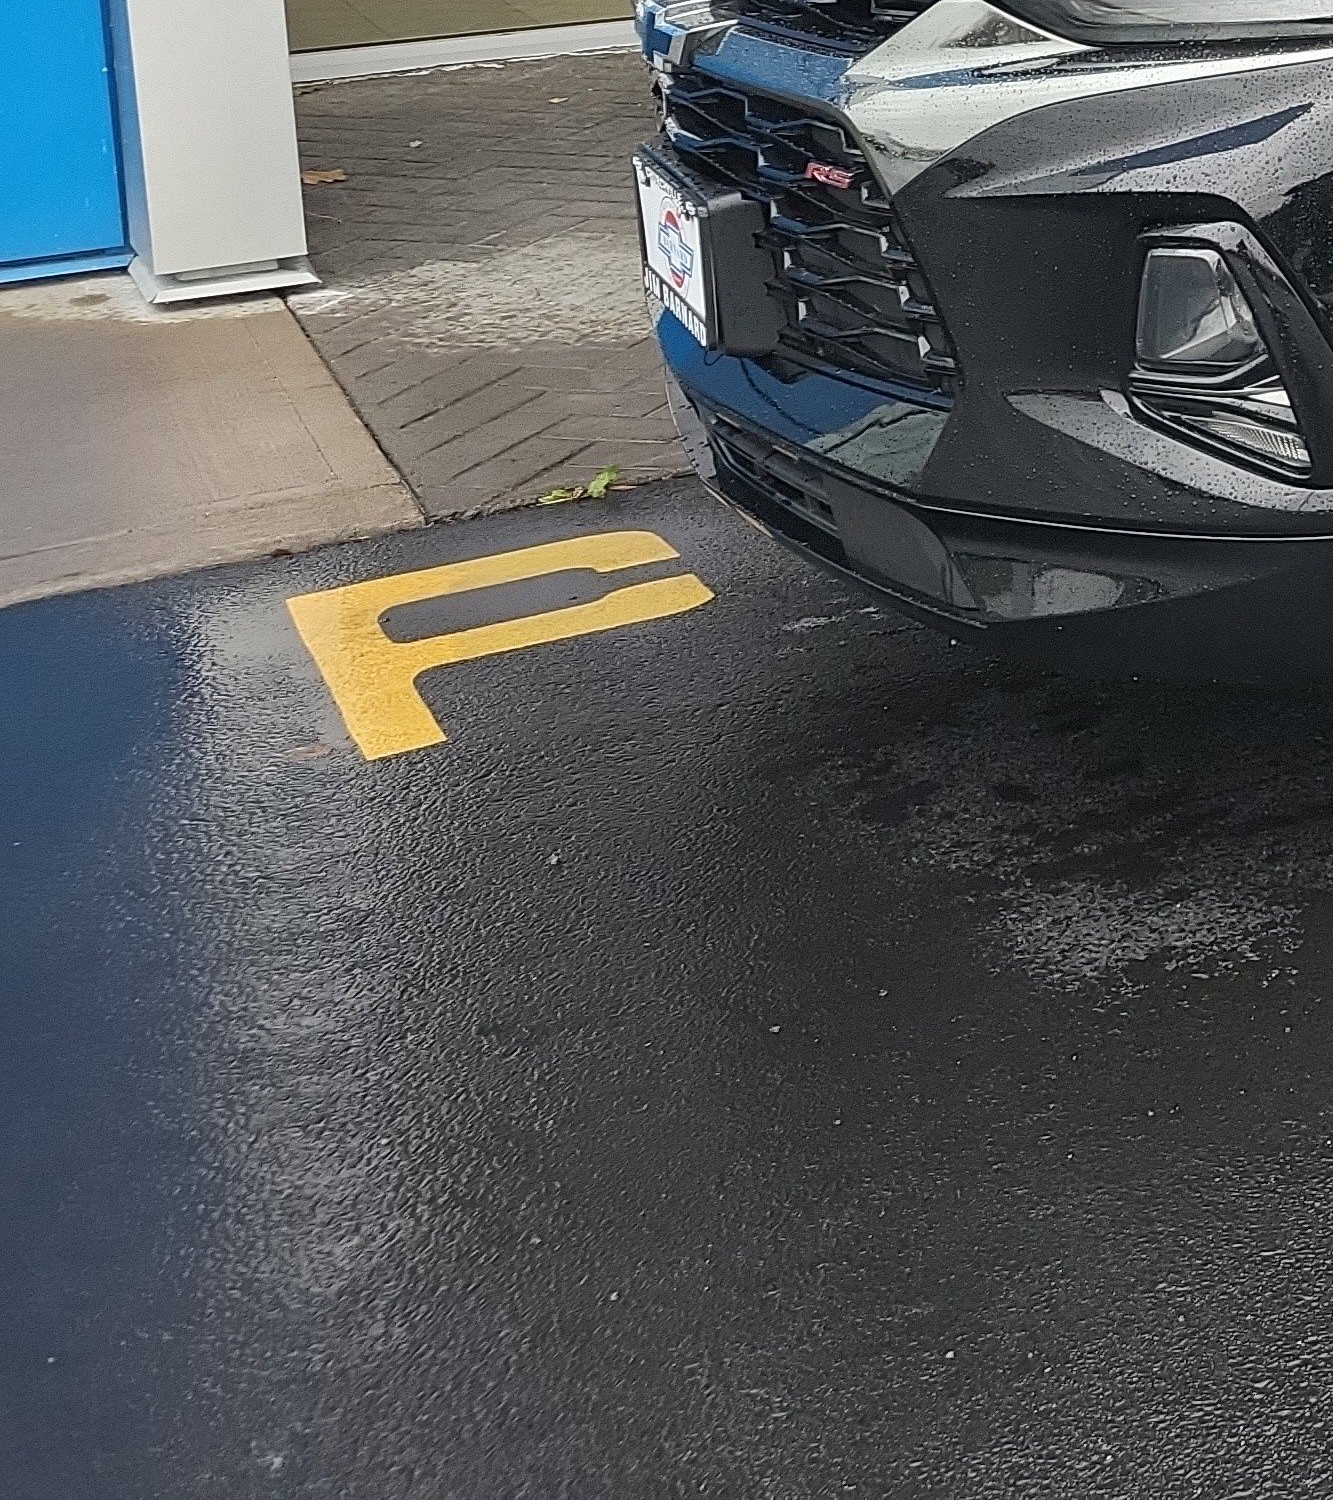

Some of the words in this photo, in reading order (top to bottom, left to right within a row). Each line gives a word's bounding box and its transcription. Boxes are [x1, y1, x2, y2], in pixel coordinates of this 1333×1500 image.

[804, 162, 854, 190] RS
[643, 266, 661, 300] JIM
[662, 283, 707, 348] BARNARD
